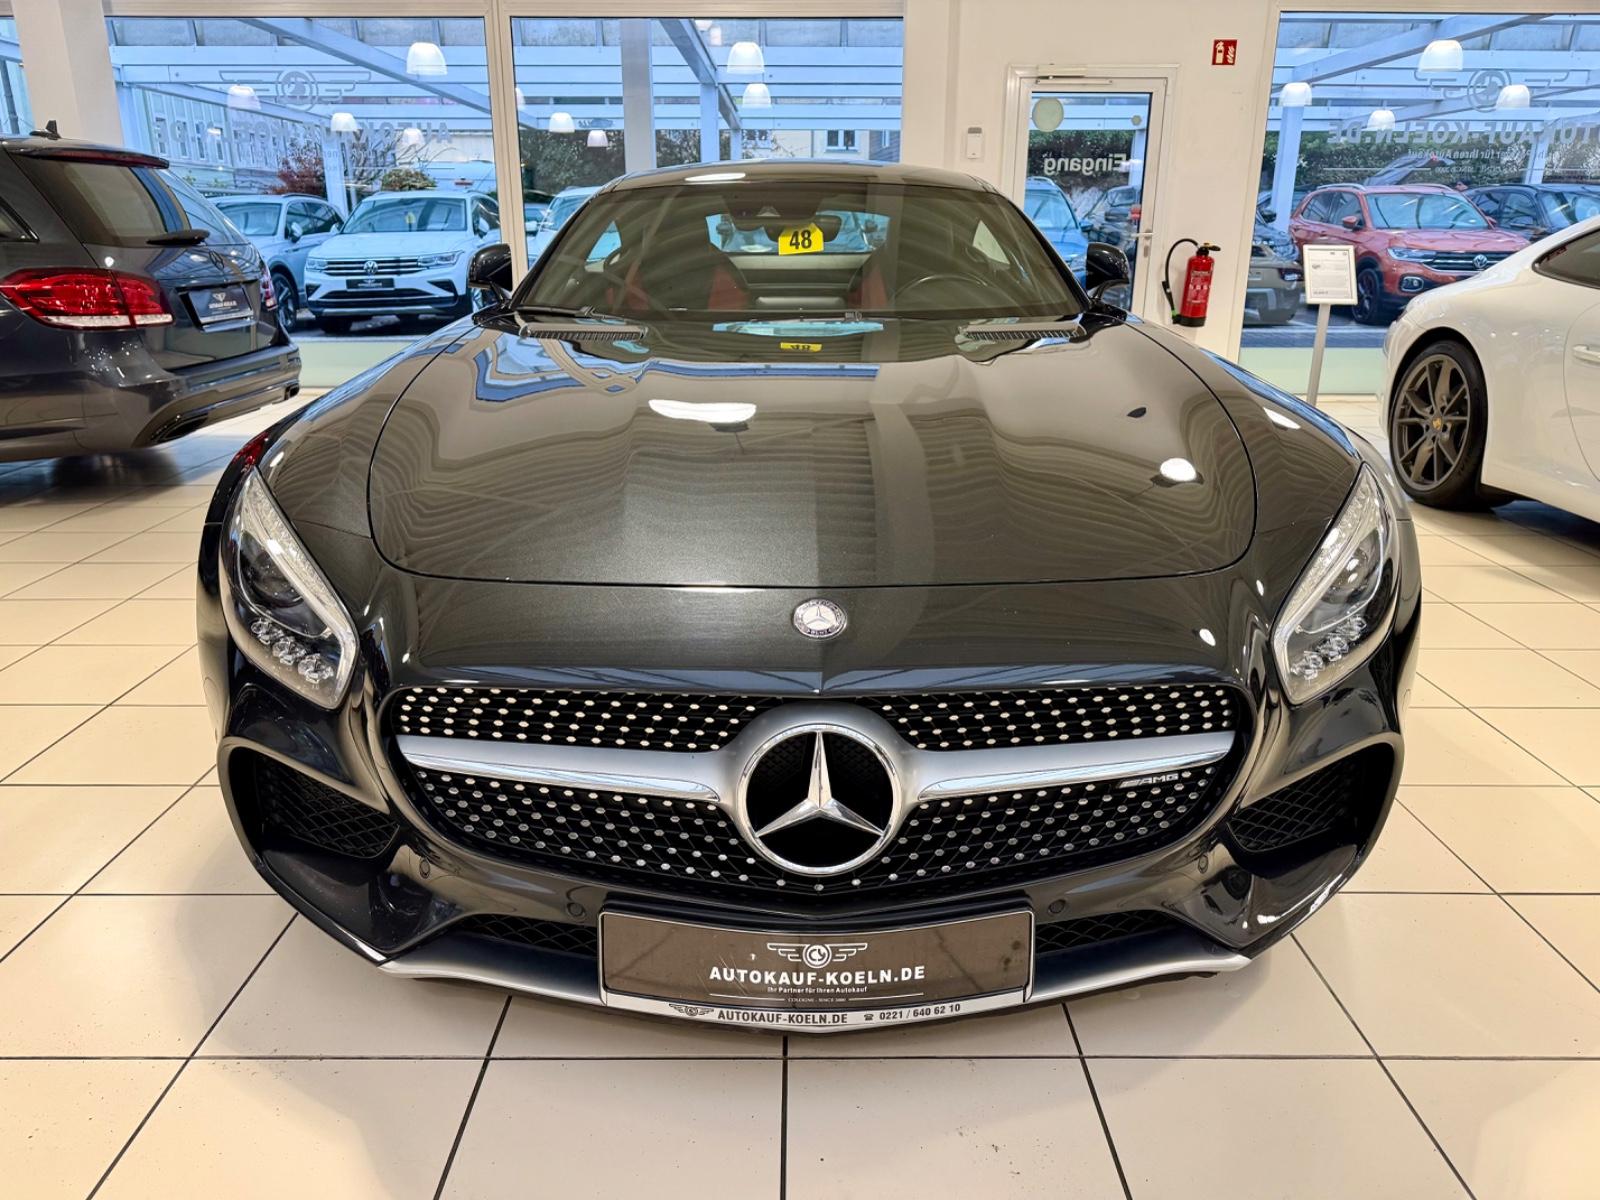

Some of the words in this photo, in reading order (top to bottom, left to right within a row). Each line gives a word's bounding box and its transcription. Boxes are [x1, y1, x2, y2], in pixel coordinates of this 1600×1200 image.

[790, 229, 812, 249] 48
[1139, 773, 1179, 785] AMG
[709, 965, 926, 986] AUTOKAUF-KOELN.DE
[835, 985, 868, 994] Autokauf
[717, 1010, 849, 1025] AUTOKAUF-KOELN.DE
[879, 1010, 904, 1021] 0221
[912, 1007, 932, 1018] 640
[933, 1005, 946, 1016] 62
[949, 1003, 961, 1013] 10
